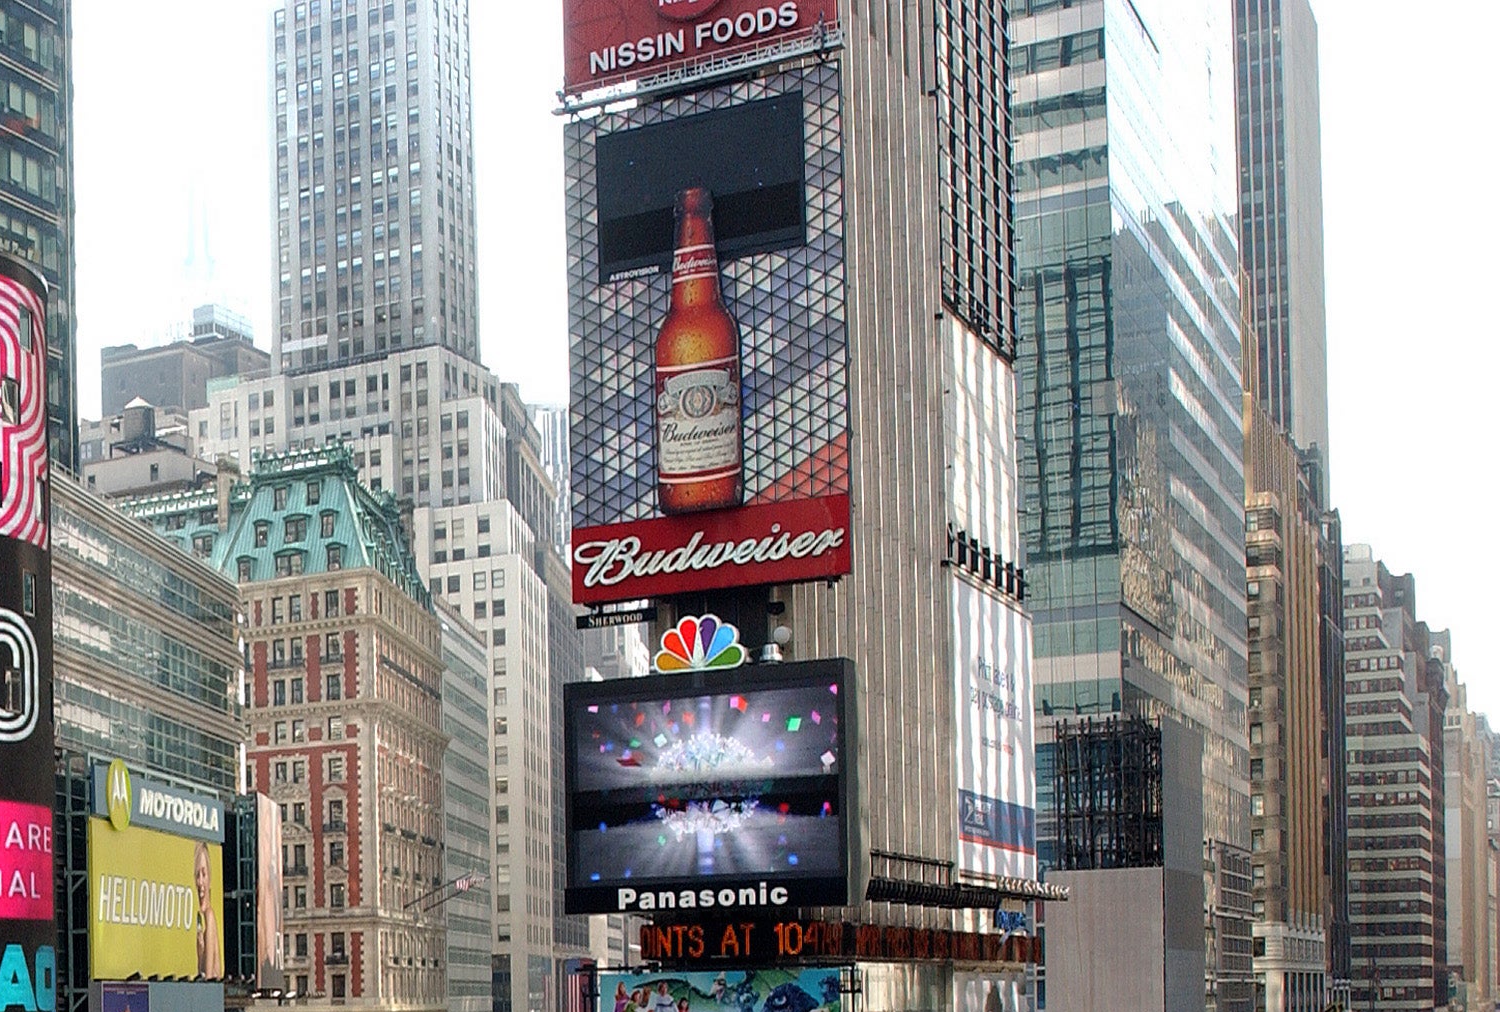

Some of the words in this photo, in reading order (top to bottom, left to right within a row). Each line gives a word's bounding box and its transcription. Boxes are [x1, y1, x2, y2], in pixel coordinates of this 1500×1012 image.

[589, 29, 684, 75] NISSIN
[694, 1, 798, 49] FOODS
[662, 421, 736, 443] Budweiser
[574, 523, 845, 588] Budweiser
[587, 611, 644, 628] SHERWOOD
[139, 787, 220, 833] MOTOROLA
[97, 874, 194, 932] HELLOMOTO
[616, 881, 789, 911] Panasonic
[721, 923, 756, 957] AT
